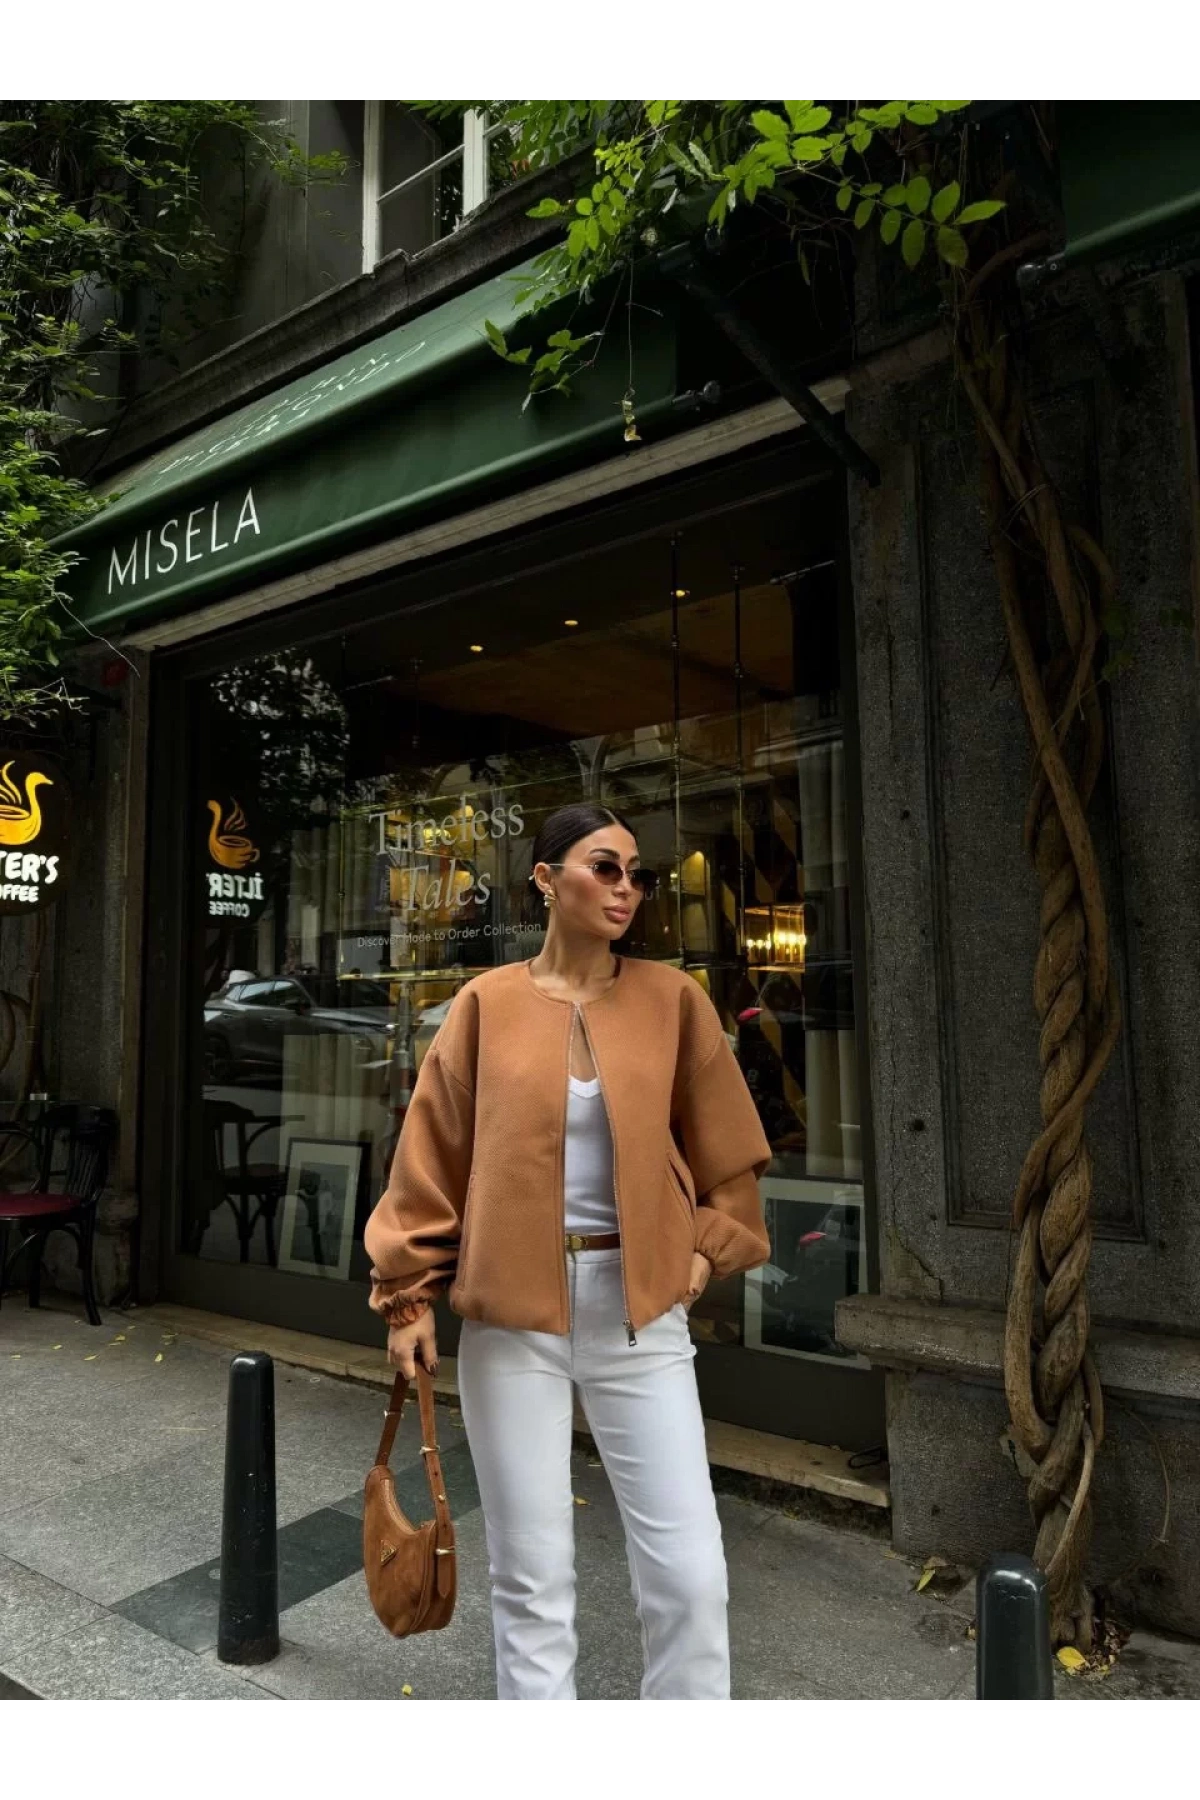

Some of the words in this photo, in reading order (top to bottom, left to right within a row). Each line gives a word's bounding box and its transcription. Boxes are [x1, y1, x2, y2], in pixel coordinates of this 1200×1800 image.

[107, 486, 261, 595] MISELA
[369, 794, 526, 856] Timeless
[401, 858, 492, 911] Tales
[433, 930, 446, 941] to
[448, 927, 481, 940] Order
[483, 921, 542, 936] Collection
